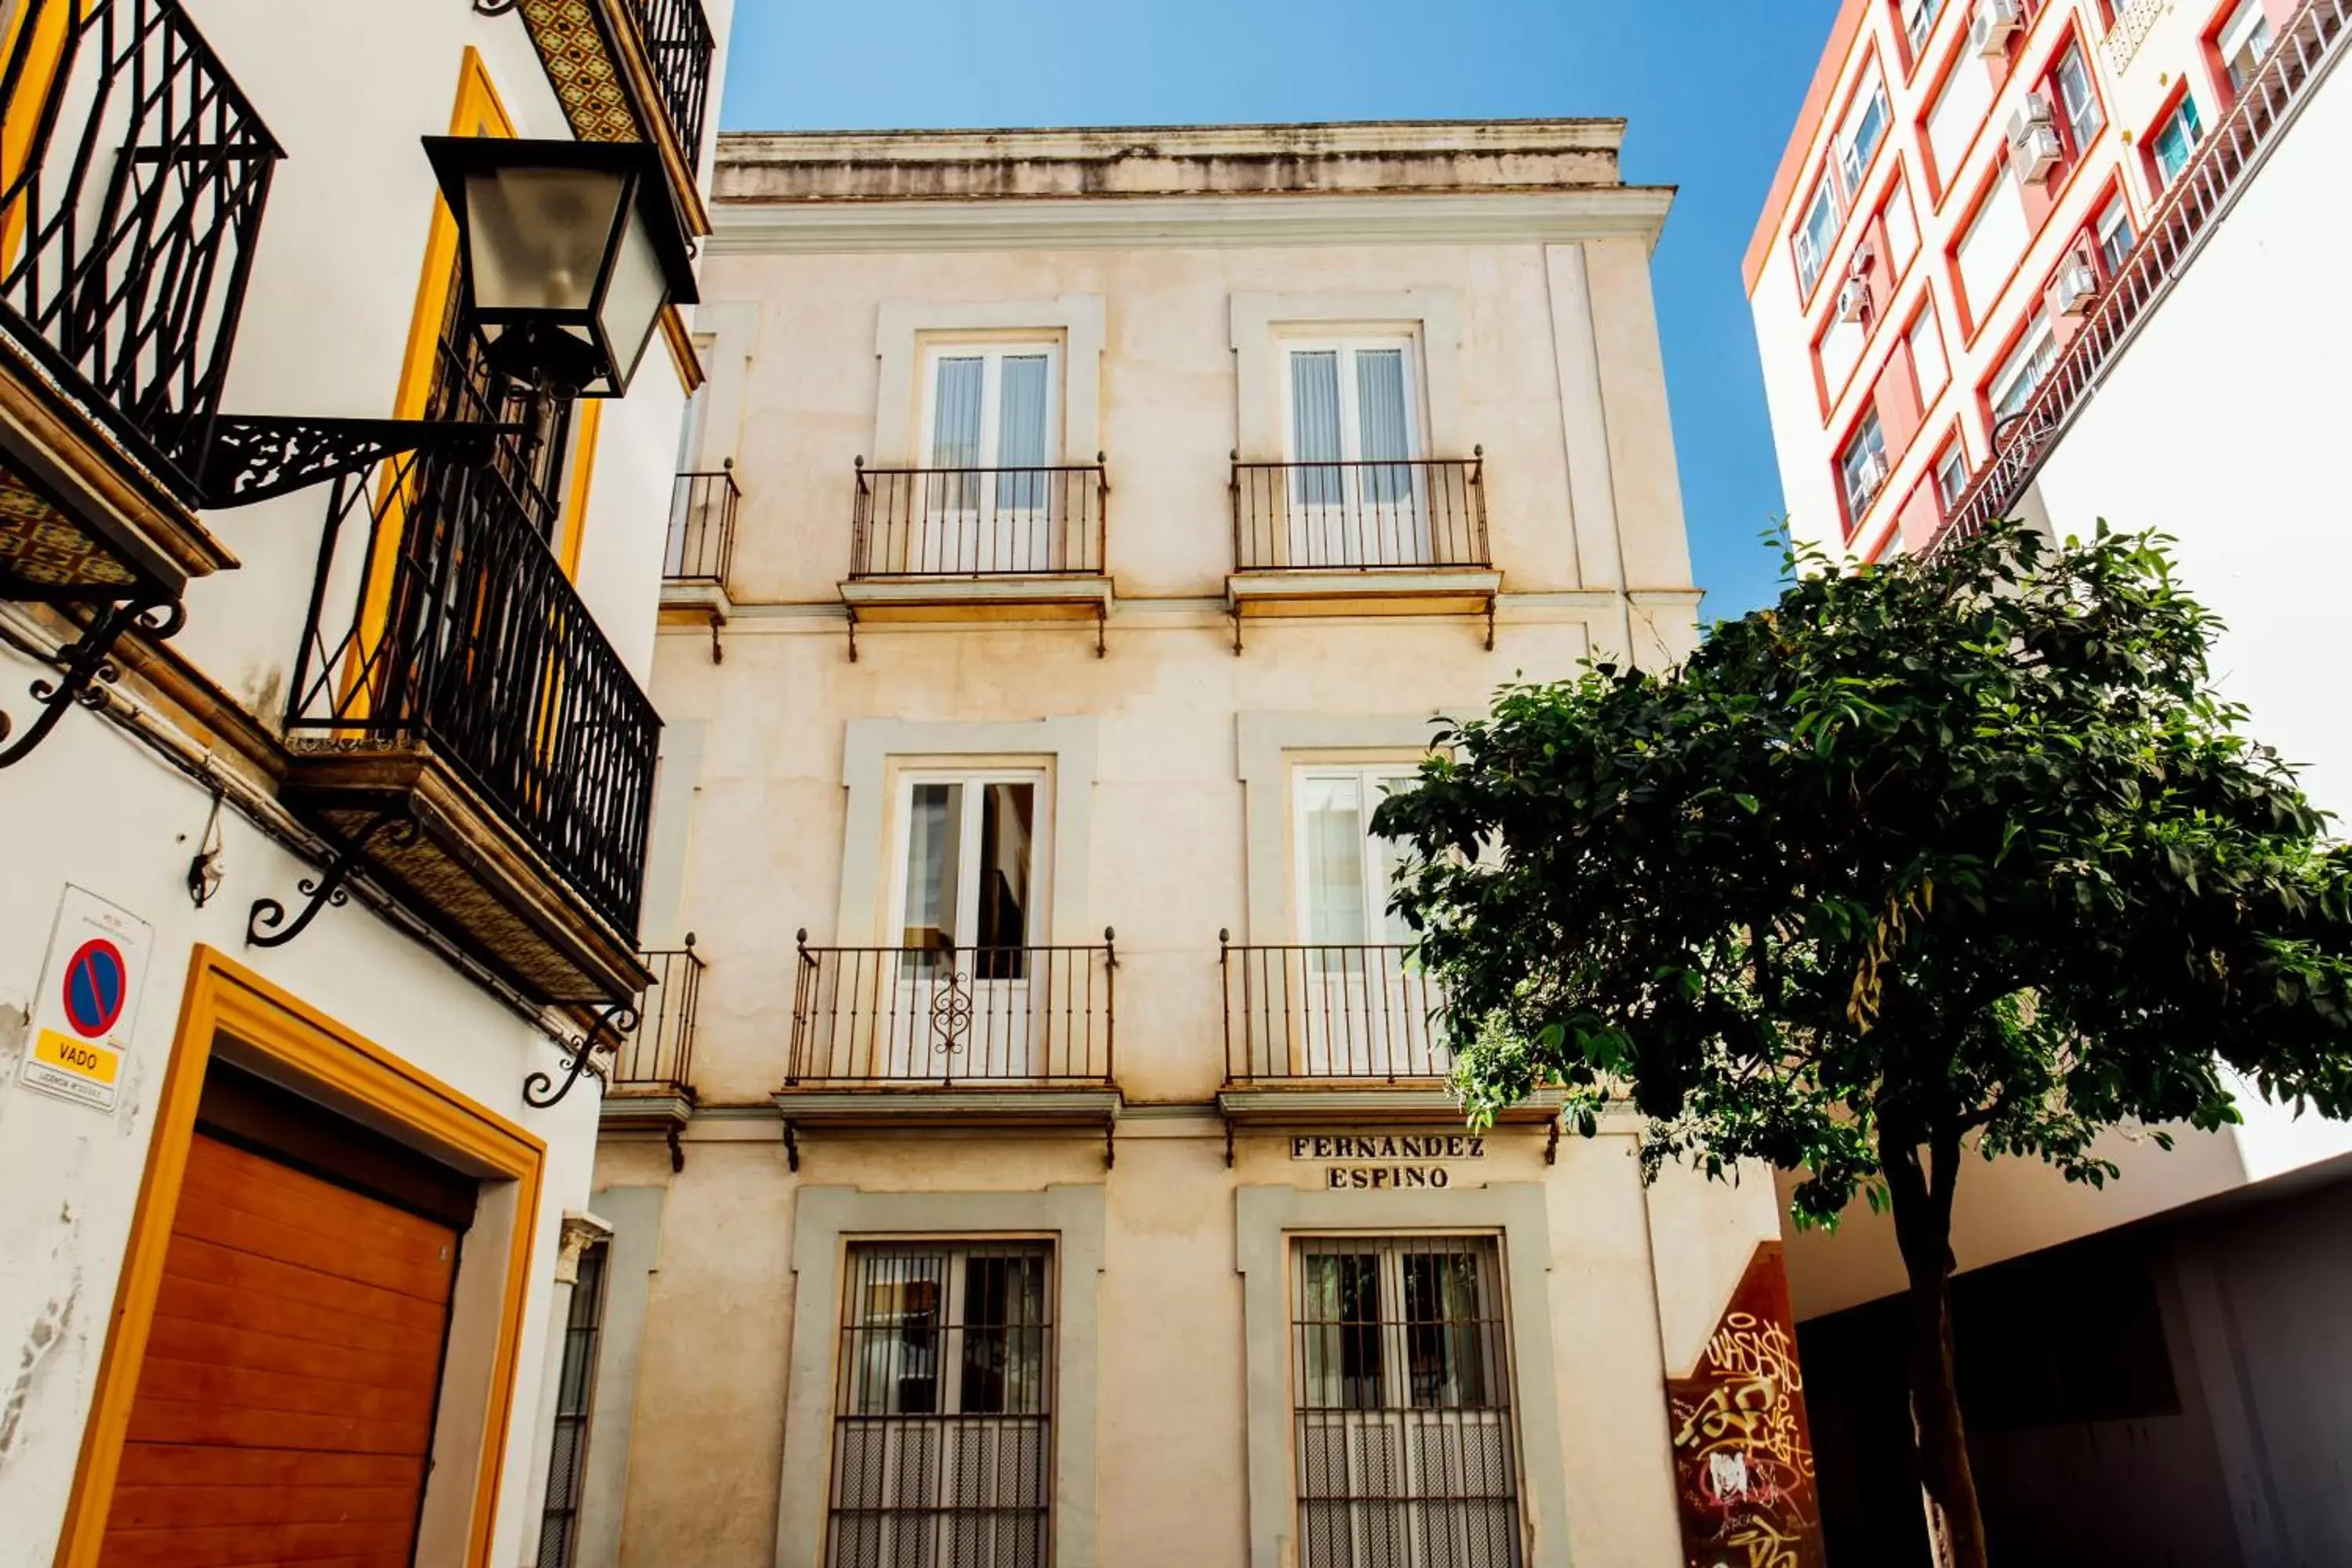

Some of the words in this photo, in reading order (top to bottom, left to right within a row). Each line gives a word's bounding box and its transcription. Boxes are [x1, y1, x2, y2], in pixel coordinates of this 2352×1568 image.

[60, 1043, 97, 1069] VADO
[1293, 1136, 1485, 1158] FERNANDEZ
[1330, 1166, 1449, 1189] ESPINO
